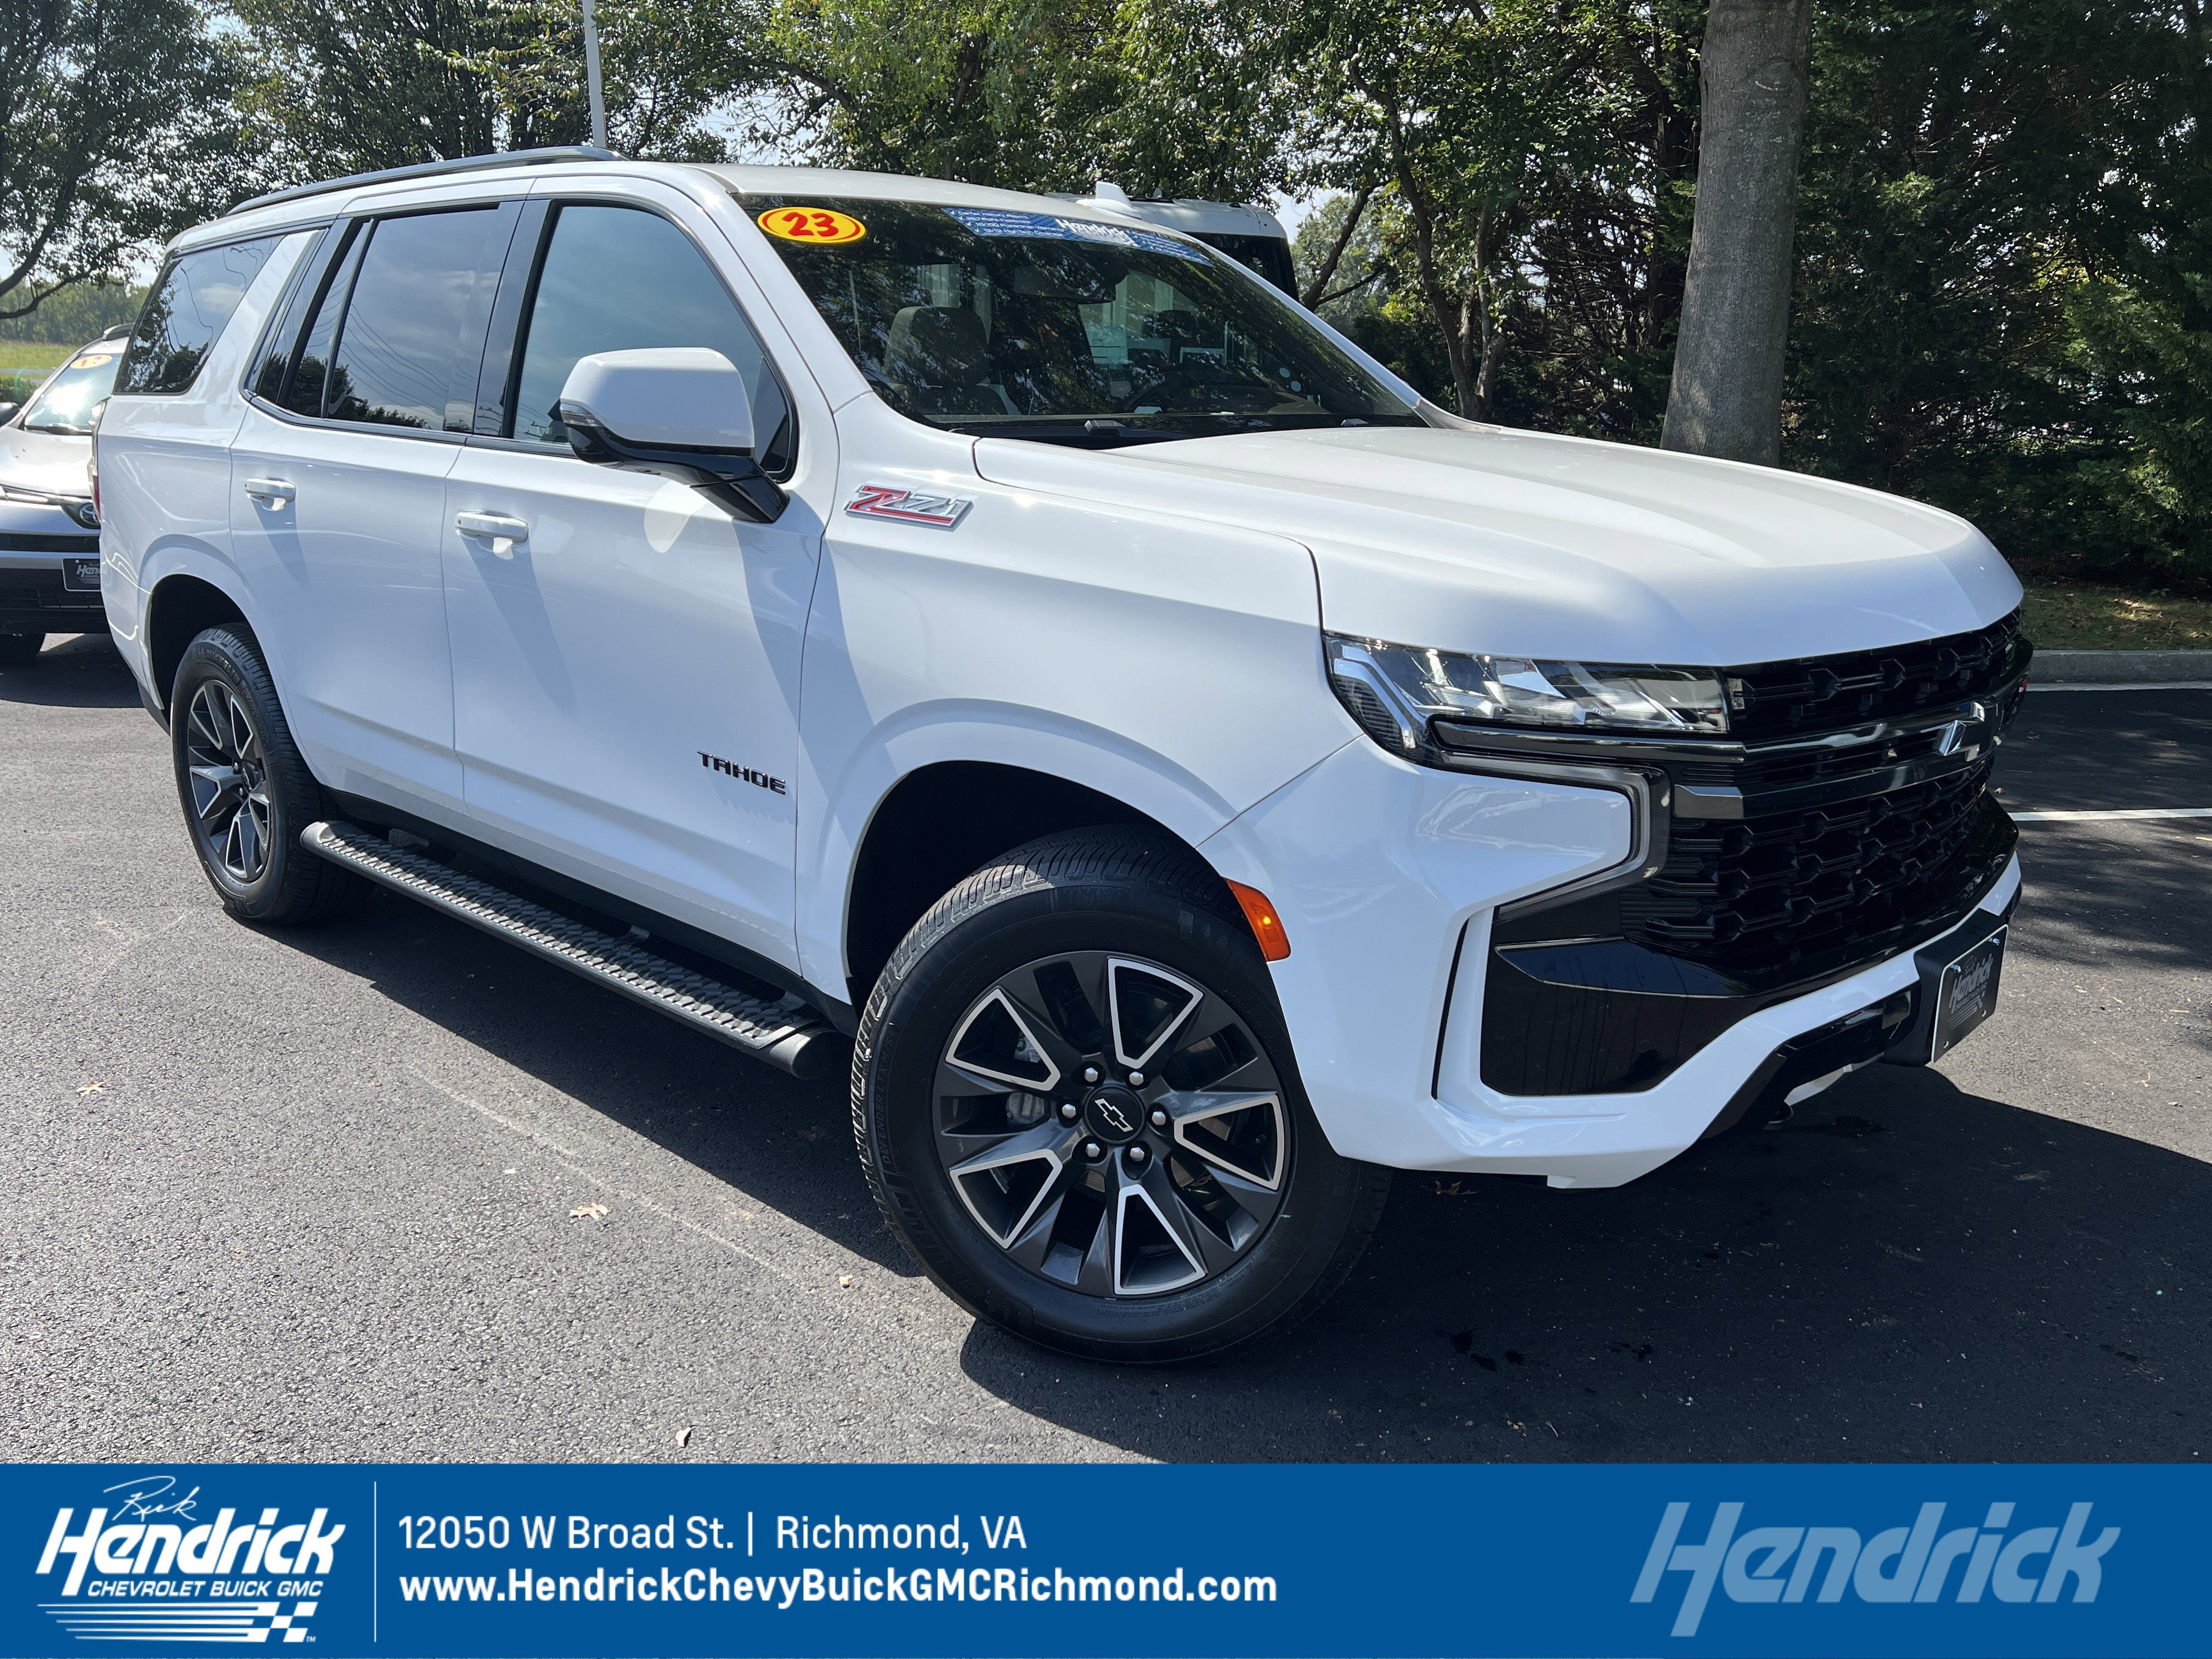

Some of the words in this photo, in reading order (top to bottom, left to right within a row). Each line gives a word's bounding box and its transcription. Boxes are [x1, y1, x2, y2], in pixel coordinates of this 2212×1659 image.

[782, 212, 839, 237] 23
[1054, 218, 1135, 243] Hendrick
[843, 483, 974, 528] Z71
[697, 749, 786, 795] TAHOE
[875, 1094, 892, 1165] DEFENDER
